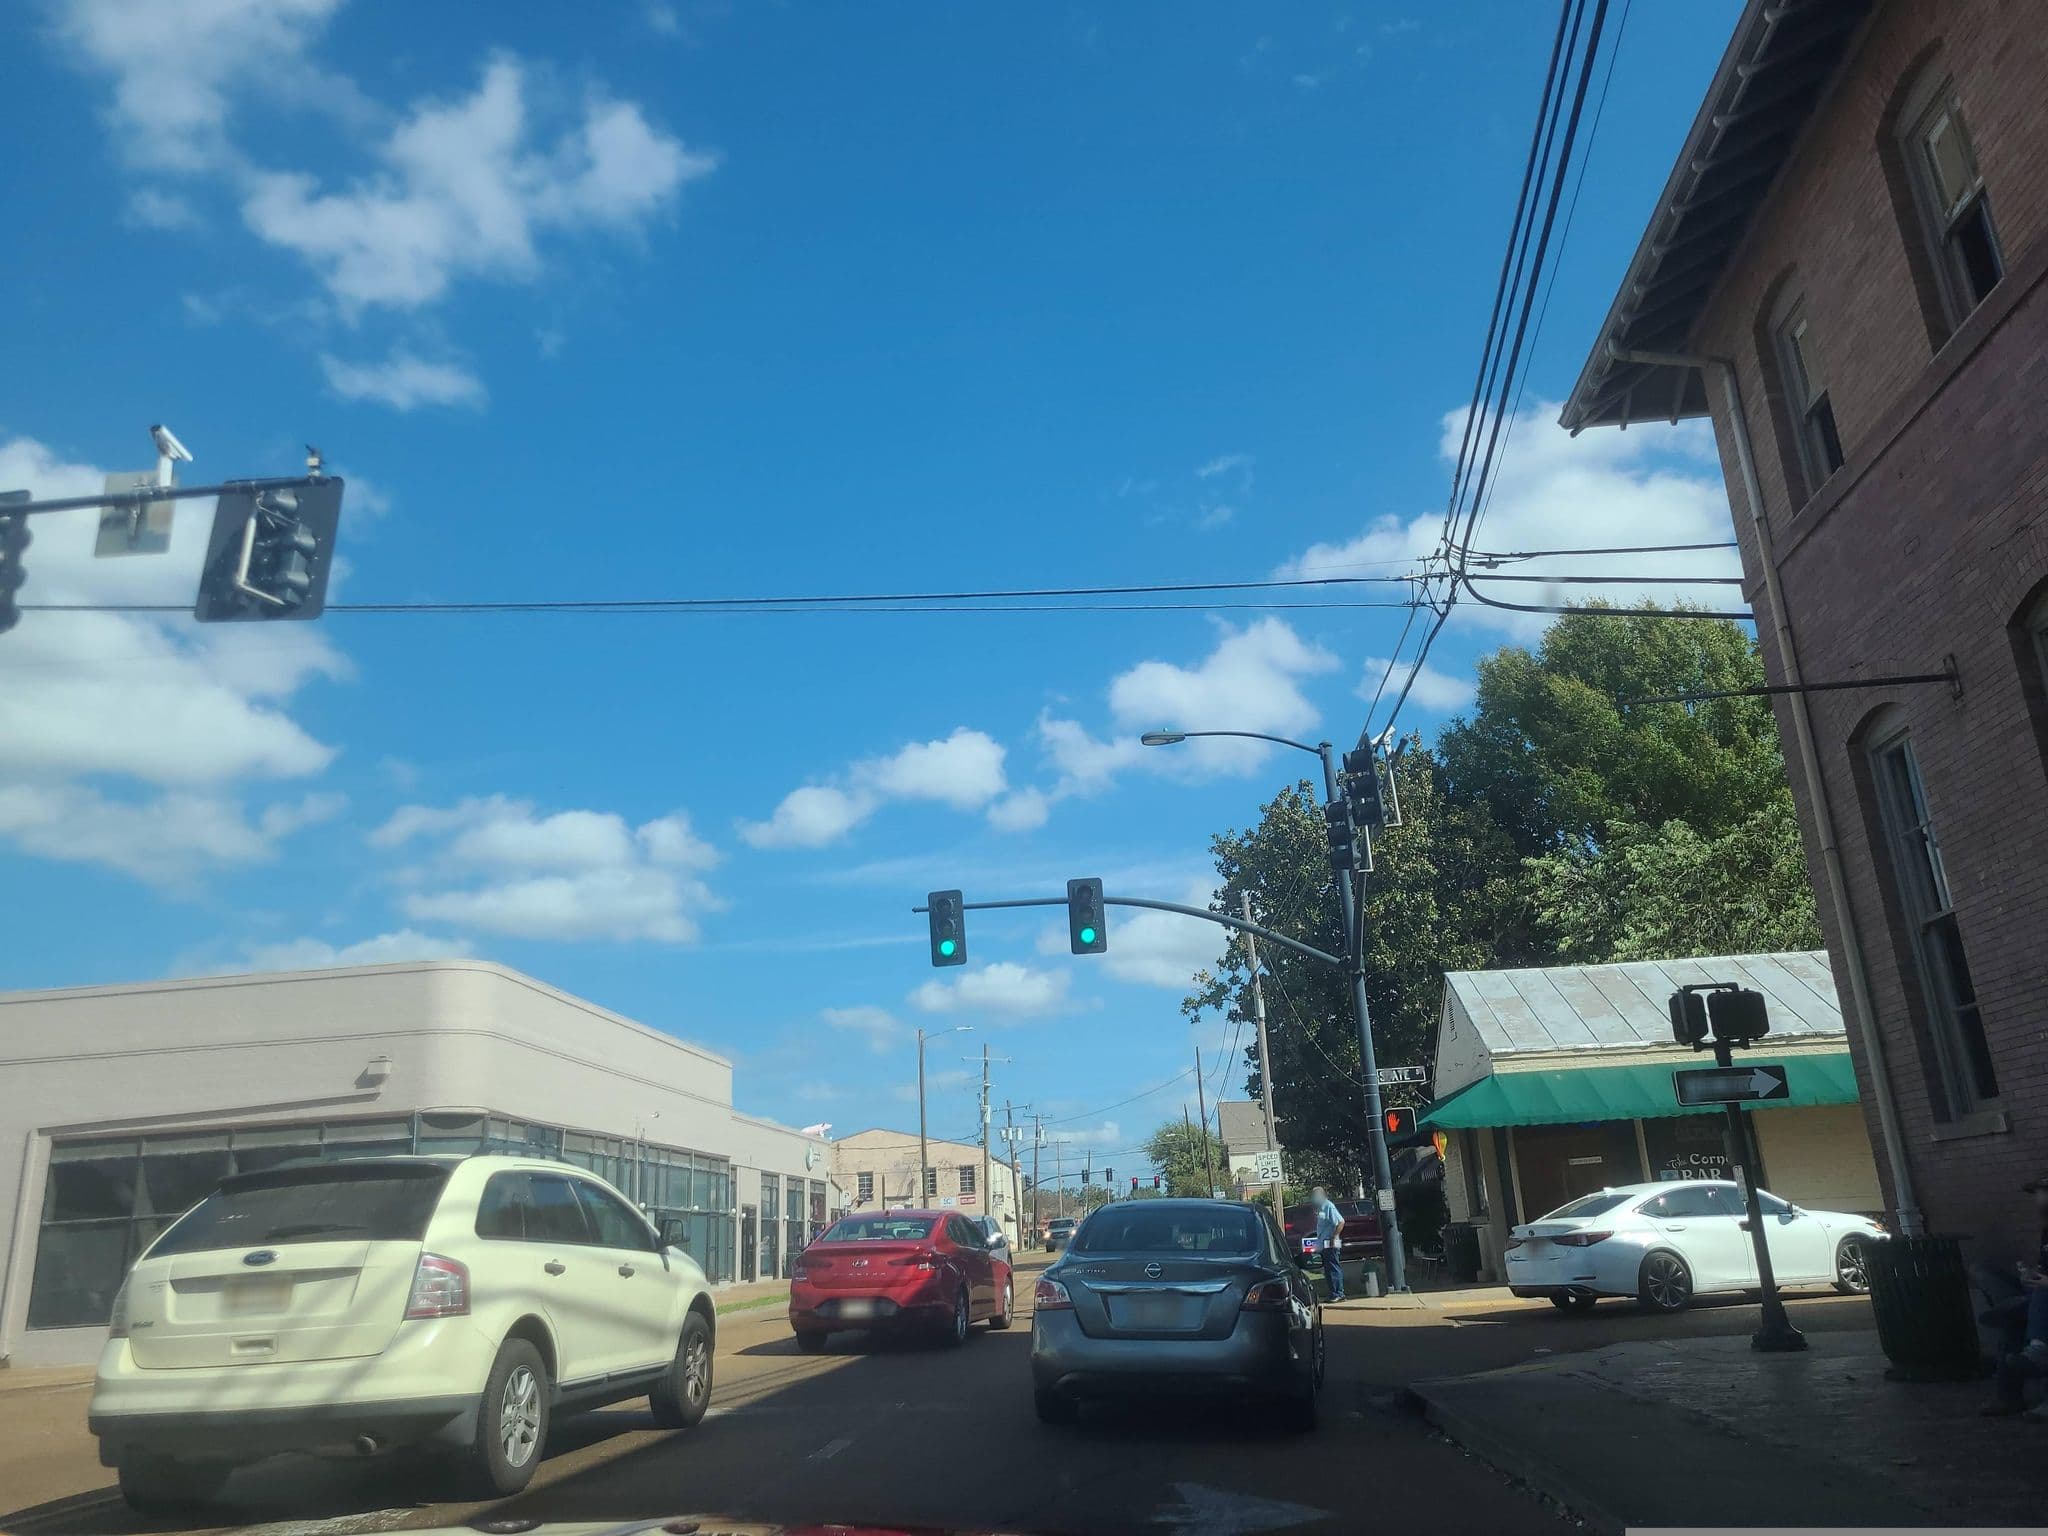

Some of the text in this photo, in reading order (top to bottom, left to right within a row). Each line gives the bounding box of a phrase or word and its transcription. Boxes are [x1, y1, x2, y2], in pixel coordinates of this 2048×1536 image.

[1379, 1069, 1411, 1082] SATE
[1257, 1153, 1278, 1161] SPEED
[1689, 1153, 1729, 1166] Corn
[1260, 1166, 1280, 1179] 25
[1681, 1168, 1721, 1181] BAR
